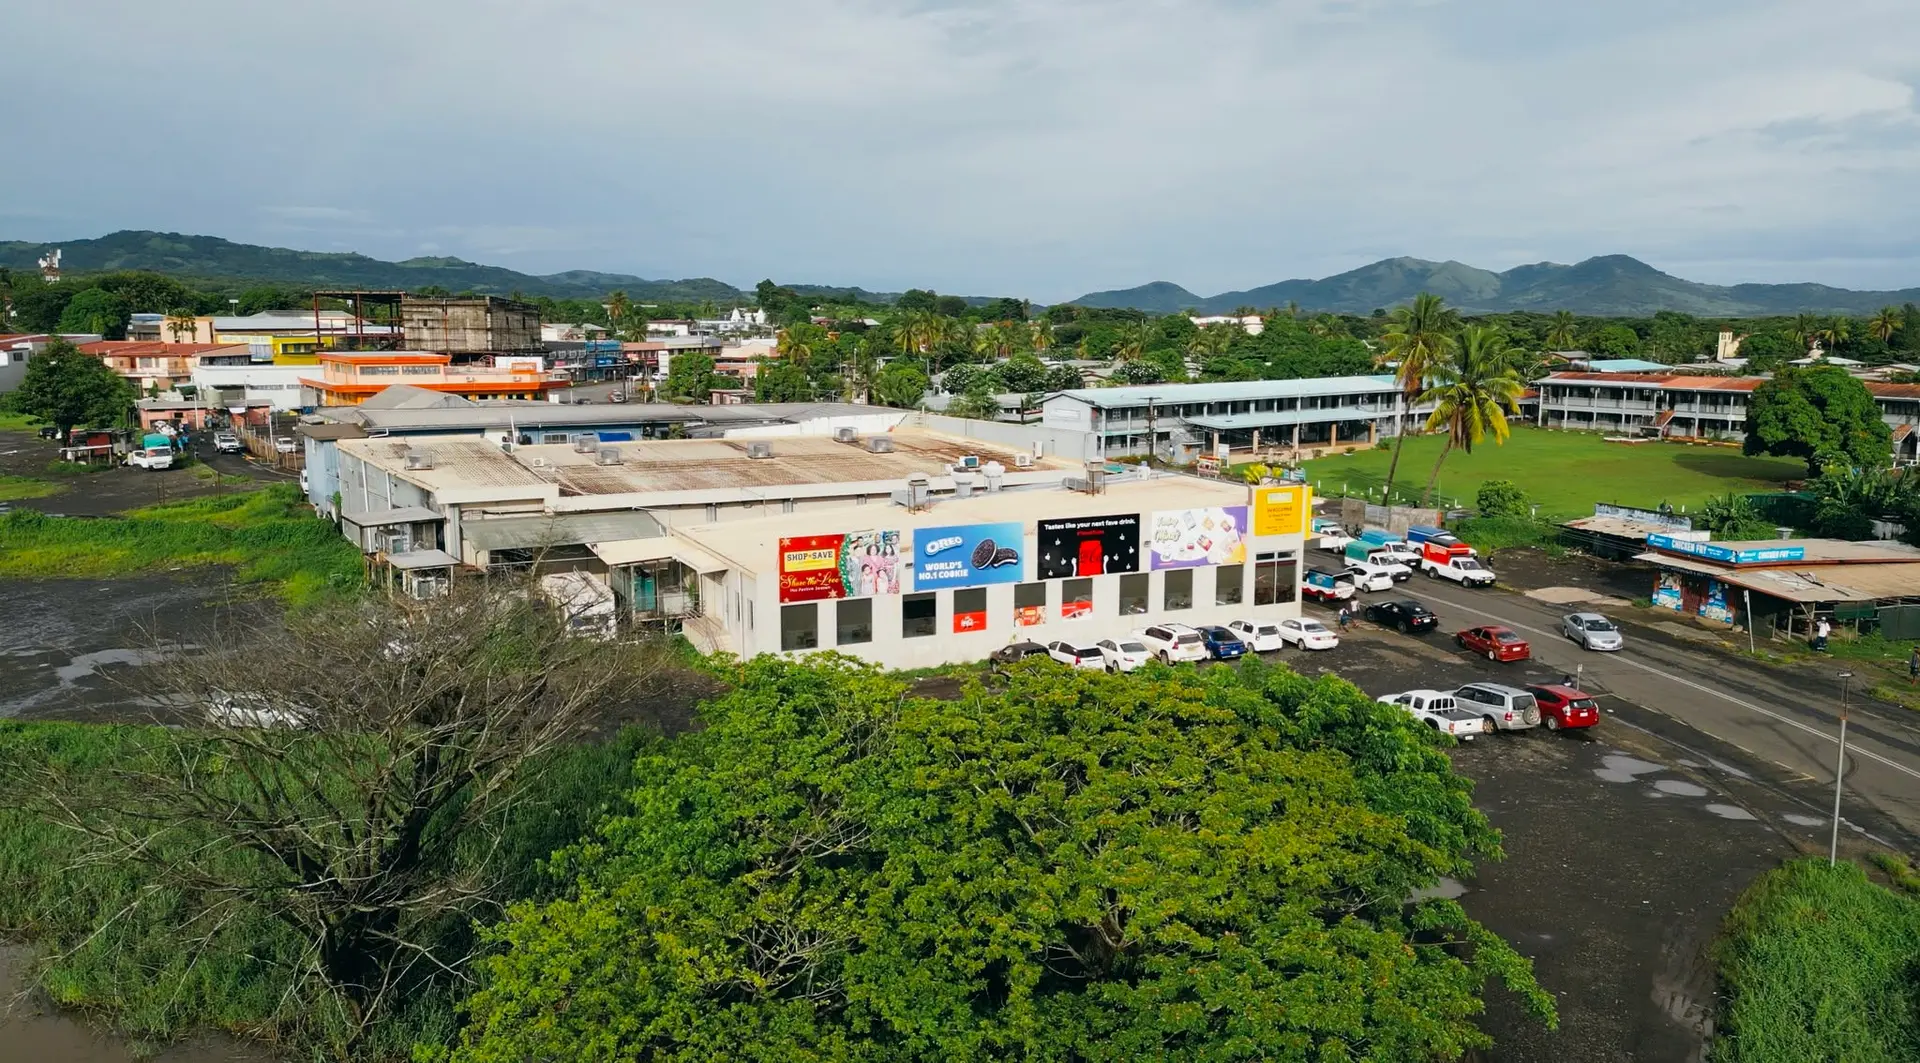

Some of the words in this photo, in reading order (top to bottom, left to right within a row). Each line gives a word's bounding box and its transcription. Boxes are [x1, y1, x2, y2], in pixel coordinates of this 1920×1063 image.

[1077, 521, 1090, 529] your
[925, 536, 963, 555] OREO
[1671, 539, 1695, 555] CHICKEN
[1695, 543, 1707, 555] FRY
[787, 552, 808, 561] SHOP
[812, 550, 833, 560] SAVE
[925, 560, 962, 571] WORLD'S
[780, 574, 806, 588] Share
[806, 576, 817, 586] the
[818, 571, 839, 586] Love
[918, 571, 937, 581] NO.1
[938, 569, 968, 578] COOKIE
